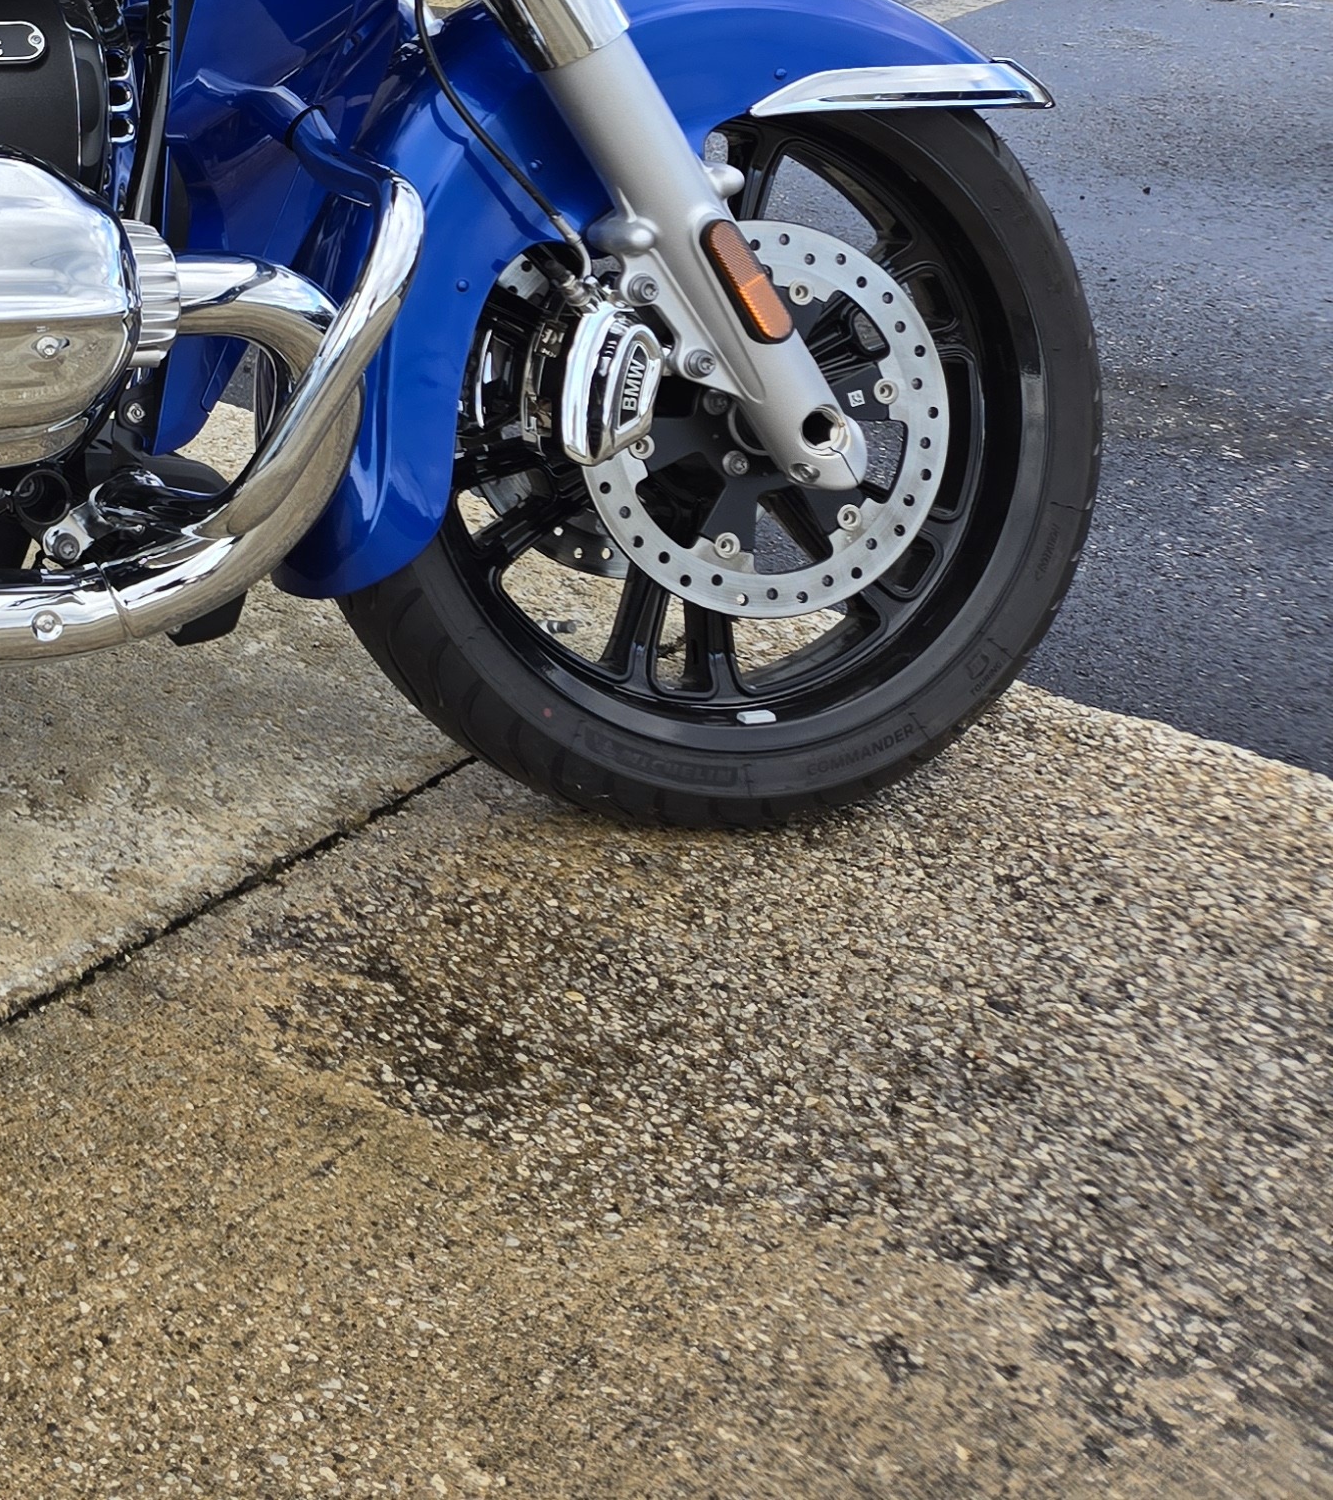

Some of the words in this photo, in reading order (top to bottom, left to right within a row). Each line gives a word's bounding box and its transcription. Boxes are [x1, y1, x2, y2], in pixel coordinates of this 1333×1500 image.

[622, 359, 645, 411] BMW
[970, 660, 1003, 697] TOURING
[806, 723, 915, 777] COMMANDER
